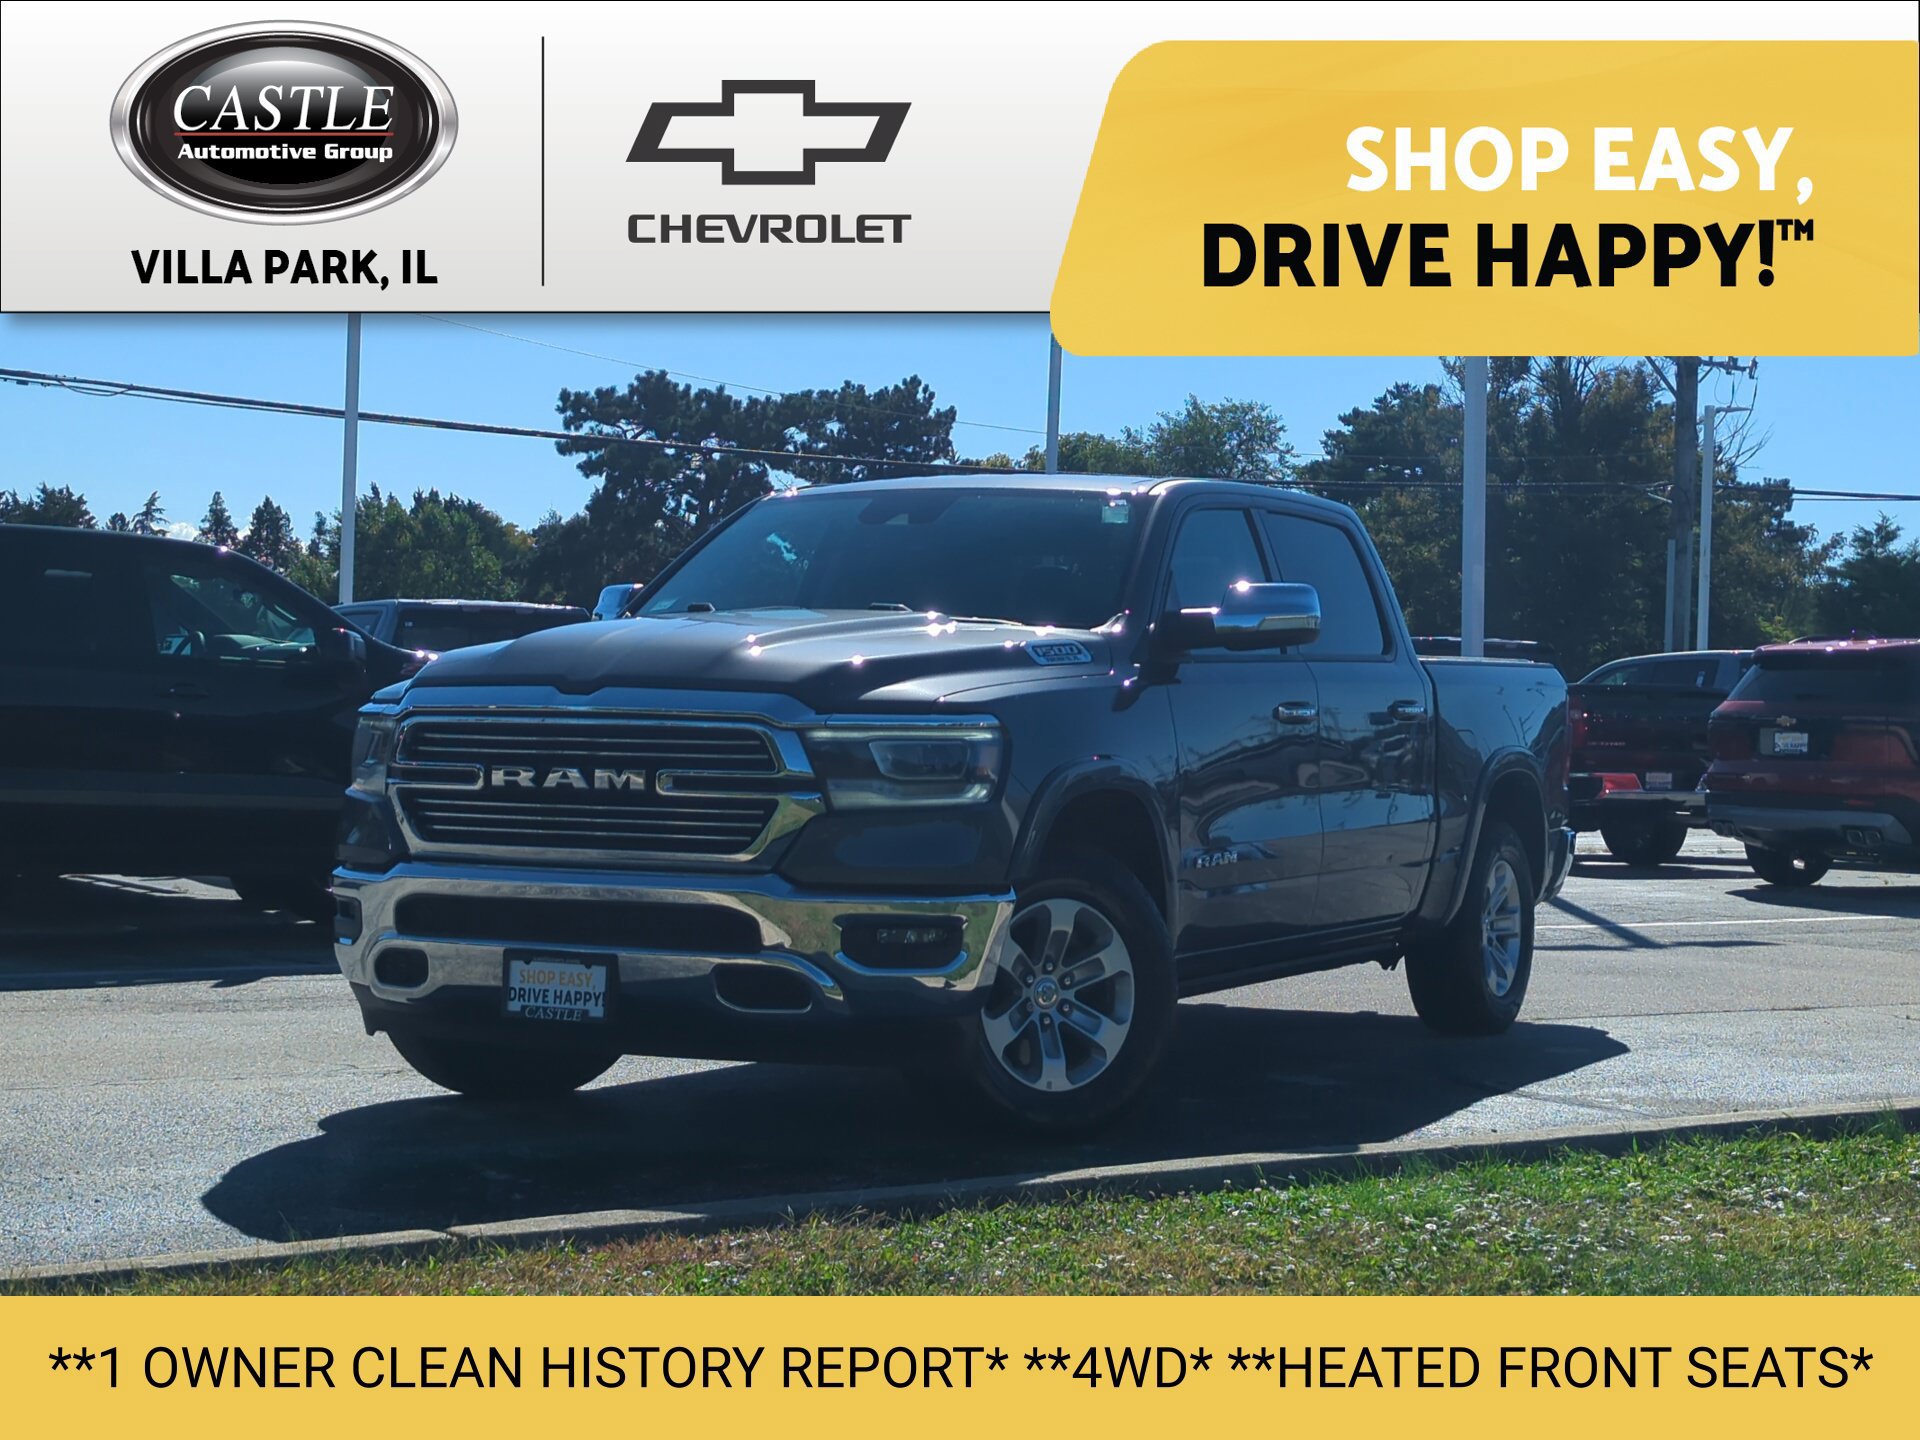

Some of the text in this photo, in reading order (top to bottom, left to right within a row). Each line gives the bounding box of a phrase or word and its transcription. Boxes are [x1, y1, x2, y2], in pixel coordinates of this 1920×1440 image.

[491, 765, 646, 791] RAM
[1197, 851, 1238, 868] RAM
[520, 969, 597, 991] SHOP EASY,
[508, 986, 606, 1008] DRIVE HAPPY!
[525, 1006, 582, 1021] CASTLE
